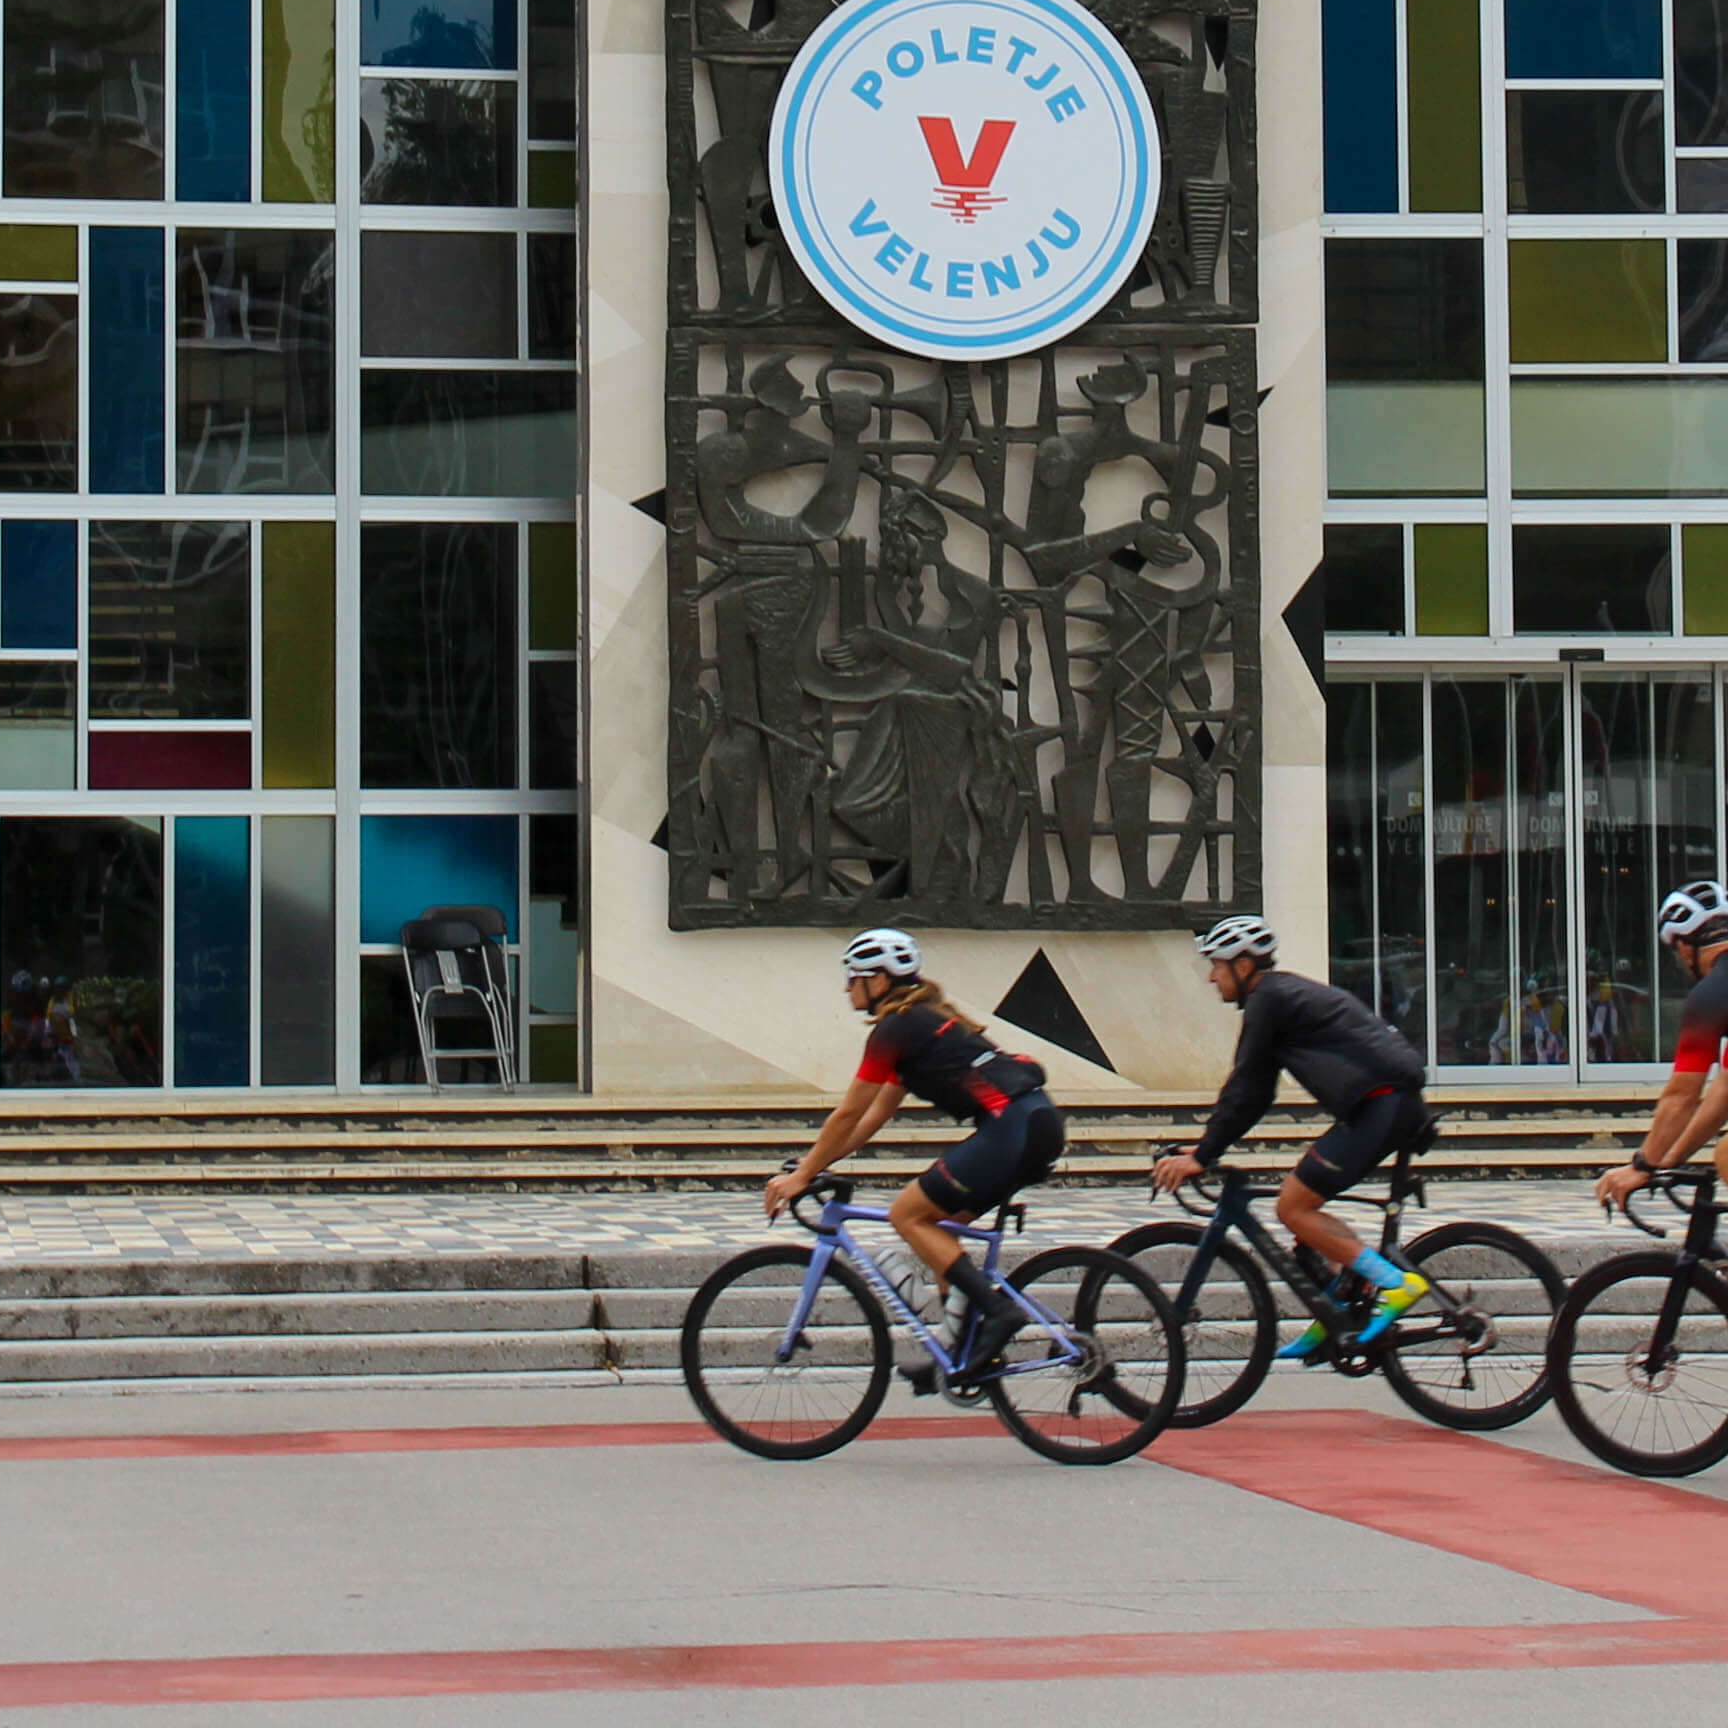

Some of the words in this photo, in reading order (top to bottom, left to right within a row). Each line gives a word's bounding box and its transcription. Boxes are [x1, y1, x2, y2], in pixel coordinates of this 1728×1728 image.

[850, 26, 1087, 122] POLETJE
[917, 116, 1017, 189] V
[848, 198, 1081, 298] VELENJU
